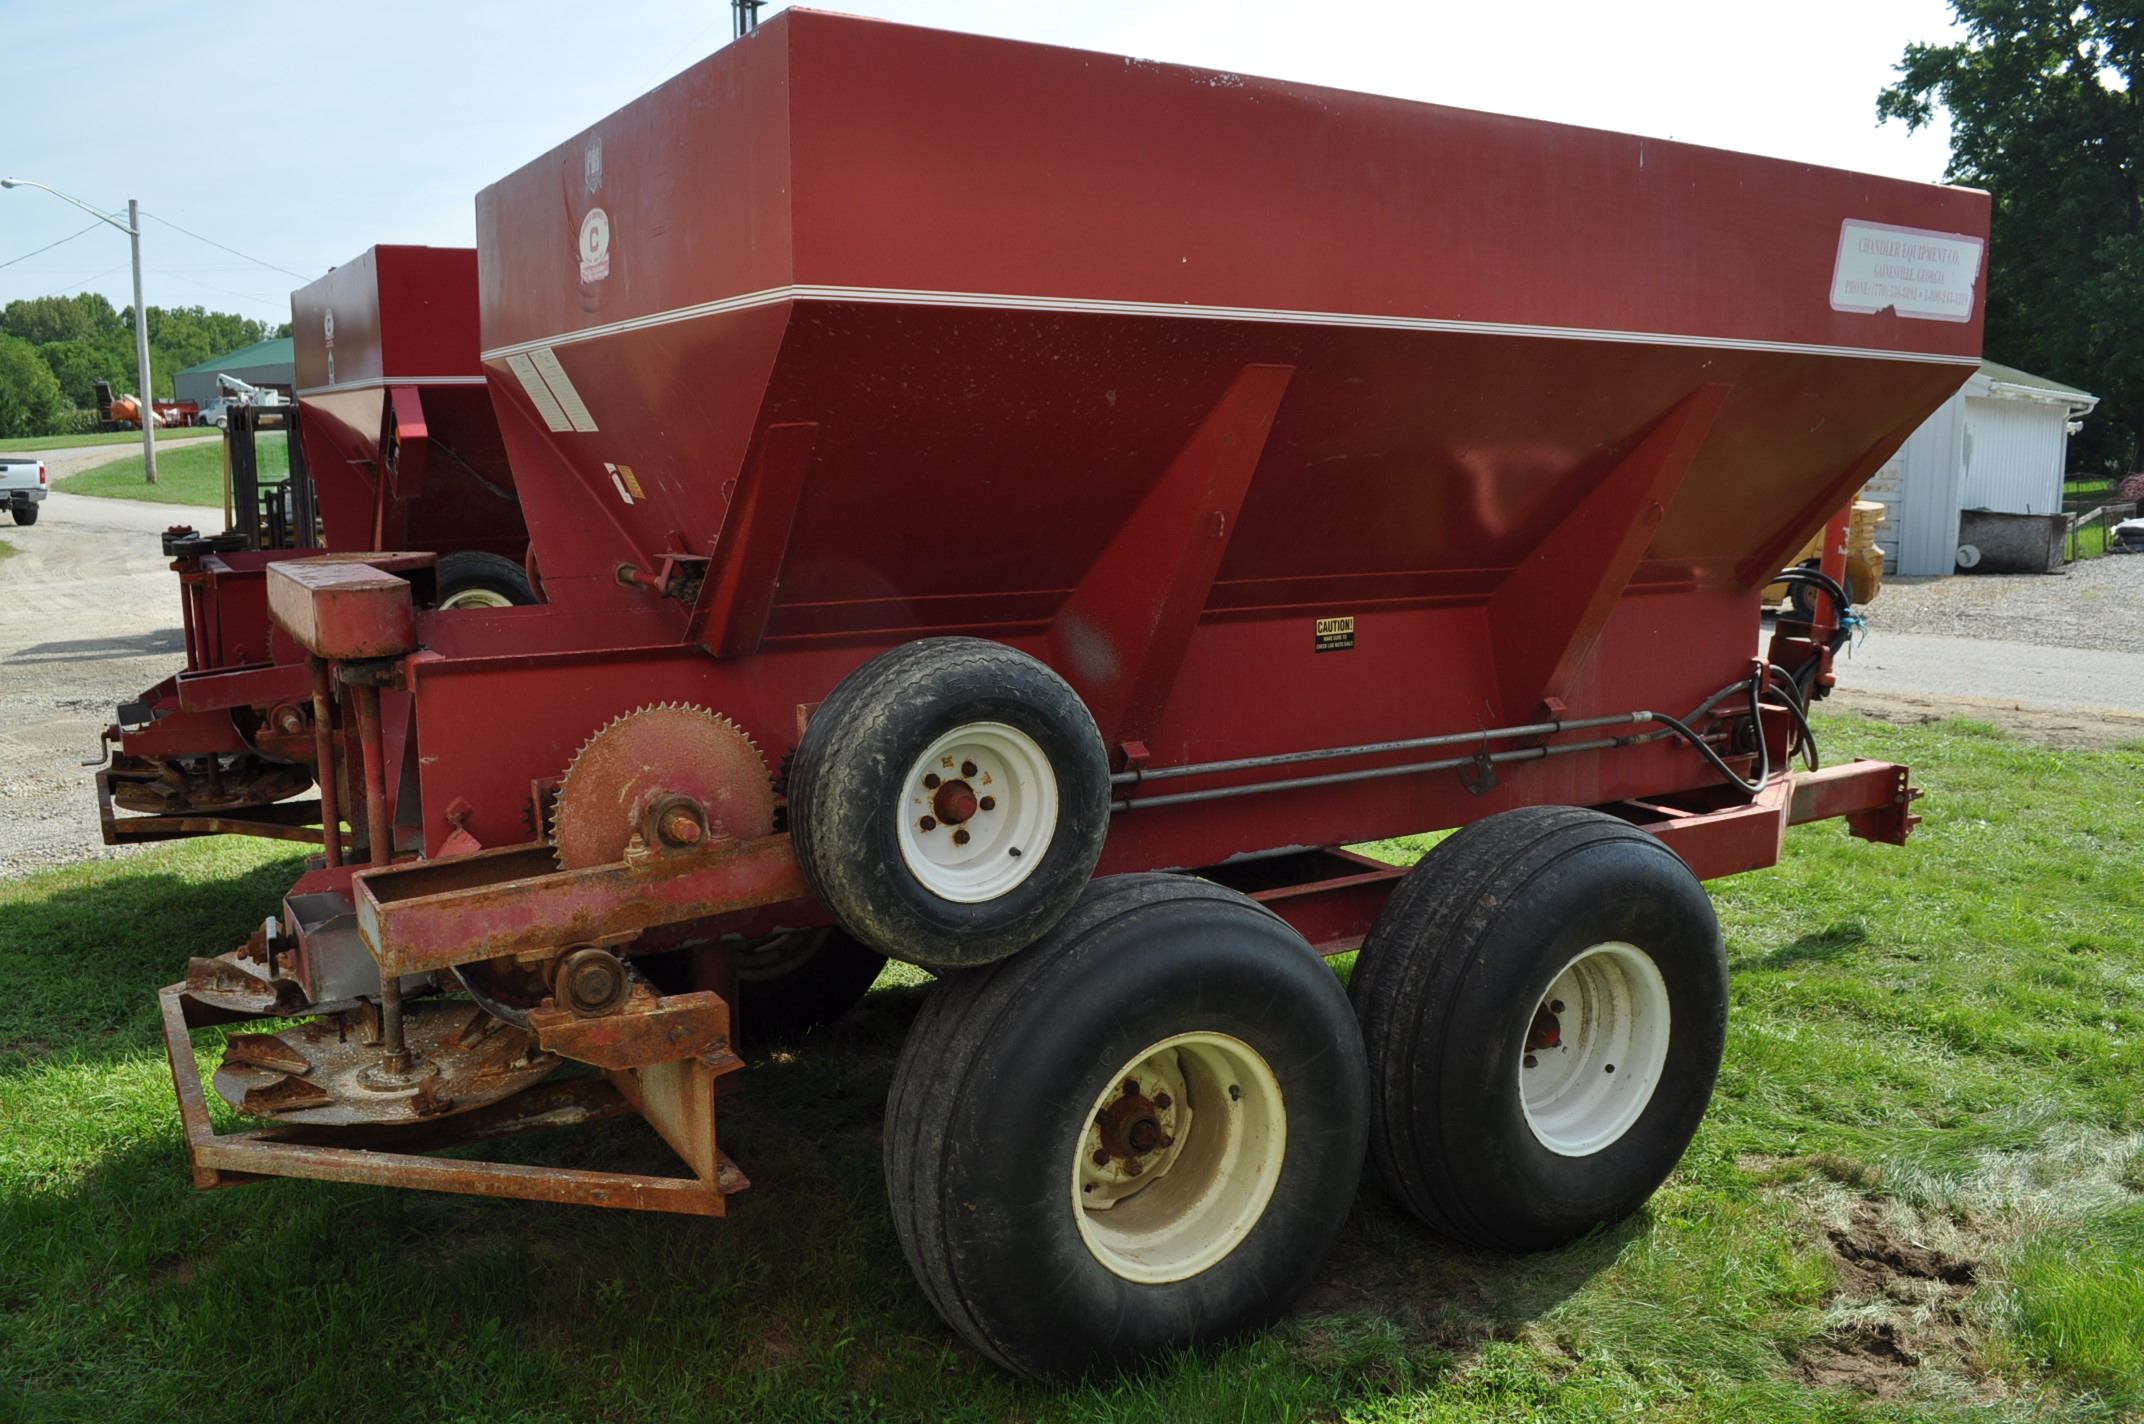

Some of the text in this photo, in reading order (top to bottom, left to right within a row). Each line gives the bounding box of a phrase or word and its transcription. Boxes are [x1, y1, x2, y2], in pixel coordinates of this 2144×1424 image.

[589, 226, 599, 253] C
[1858, 237, 1960, 265] CHANDLER EQUIPMENT CO.
[1873, 263, 1945, 285] GAINESVILLE, GEORGIA
[1845, 279, 1871, 296] PHONE:
[1871, 283, 1889, 298] (770)
[1317, 619, 1353, 633] CAUTION!
